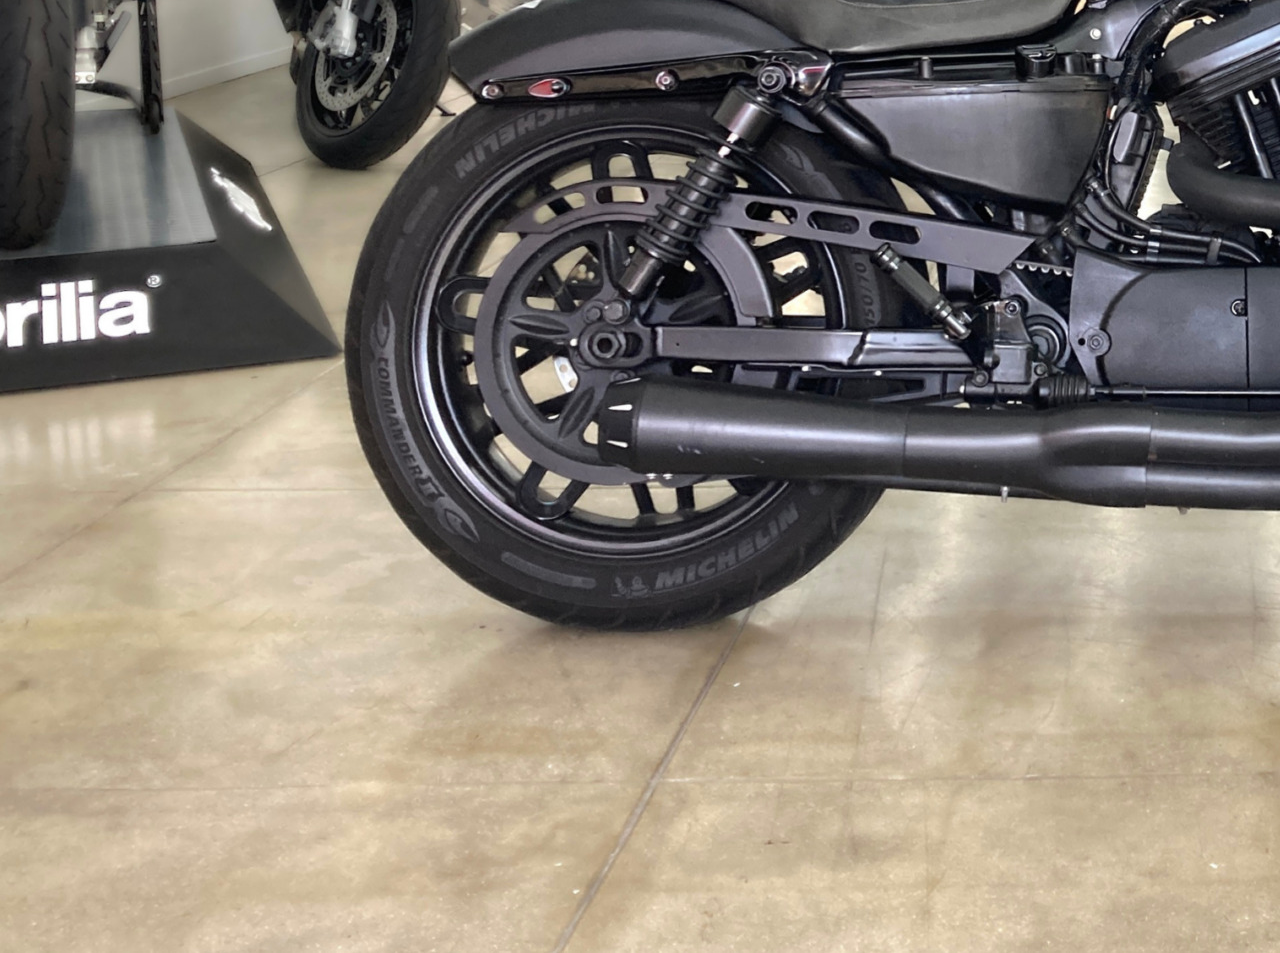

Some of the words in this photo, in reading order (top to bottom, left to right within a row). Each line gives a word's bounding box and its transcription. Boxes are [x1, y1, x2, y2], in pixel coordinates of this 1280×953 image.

[454, 102, 597, 179] MICHELIN
[0, 279, 151, 348] rilia
[377, 357, 423, 477] COMMANDER
[655, 502, 800, 590] MICHELIN
